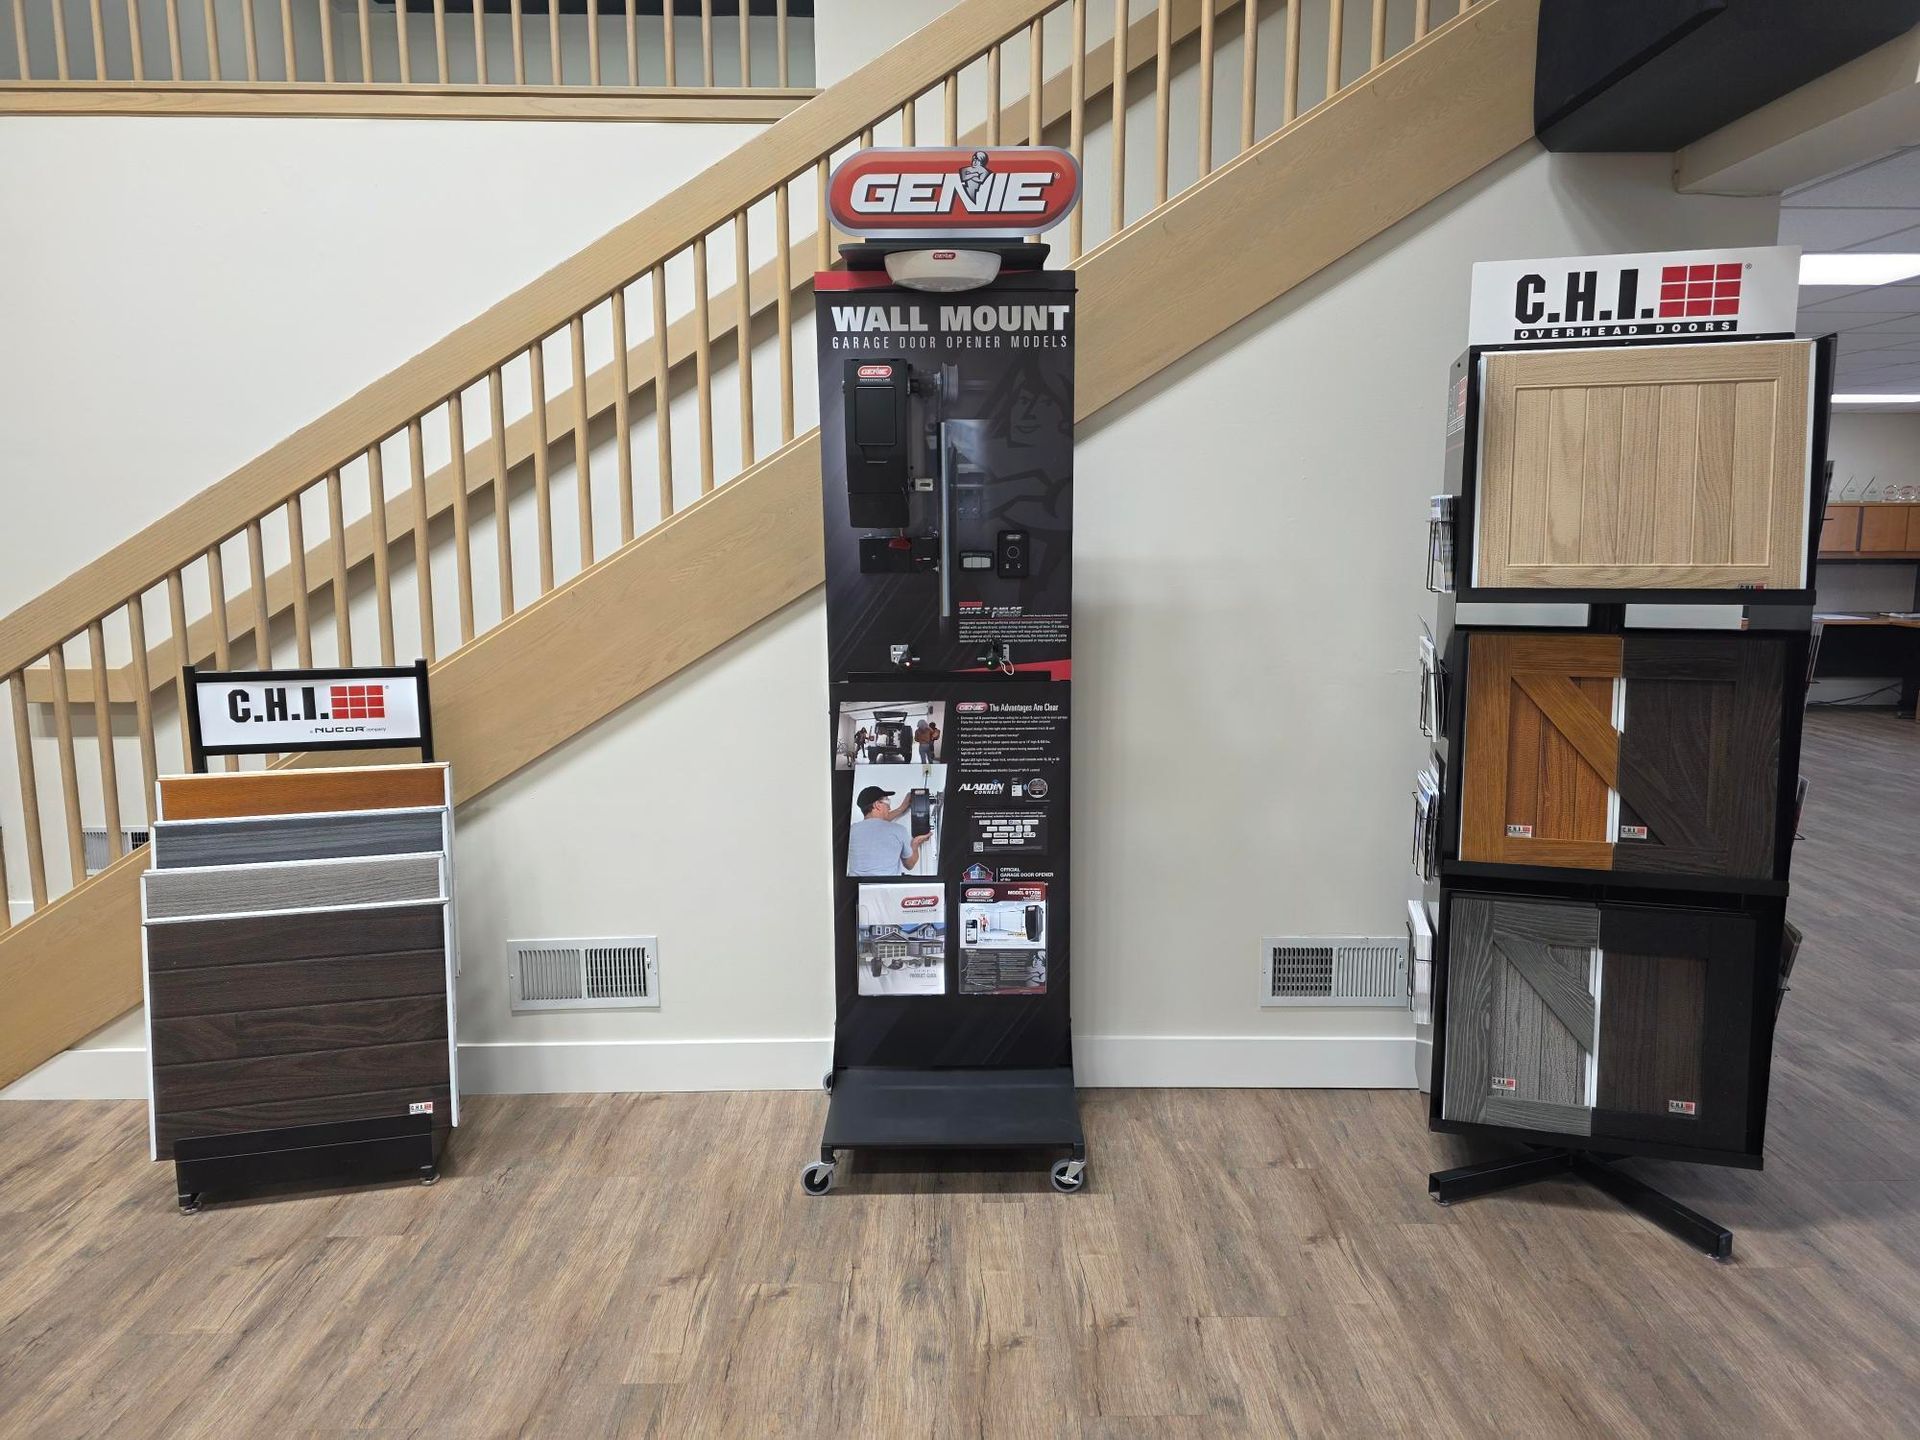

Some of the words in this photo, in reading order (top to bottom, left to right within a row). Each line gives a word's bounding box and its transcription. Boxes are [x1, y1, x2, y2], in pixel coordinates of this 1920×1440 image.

[850, 172, 1053, 213] GENIE
[1515, 268, 1654, 324] C.H.I.
[831, 306, 928, 332] WALL
[940, 305, 1070, 332] MOUNT
[1519, 325, 1638, 340] OVERHEAD
[1655, 321, 1731, 333] DOORS
[832, 335, 890, 349] GARAGE
[899, 335, 937, 349] DOOR
[946, 335, 1001, 348] OPENER
[1010, 335, 1068, 348] MODELS
[228, 686, 329, 723] C.H.I.
[989, 703, 999, 712] The
[1000, 703, 1032, 713] Advantages
[1033, 703, 1043, 712] Are
[1044, 703, 1059, 712] Clear
[314, 726, 364, 734] NUCOR
[958, 783, 1005, 792] ALADDIN
